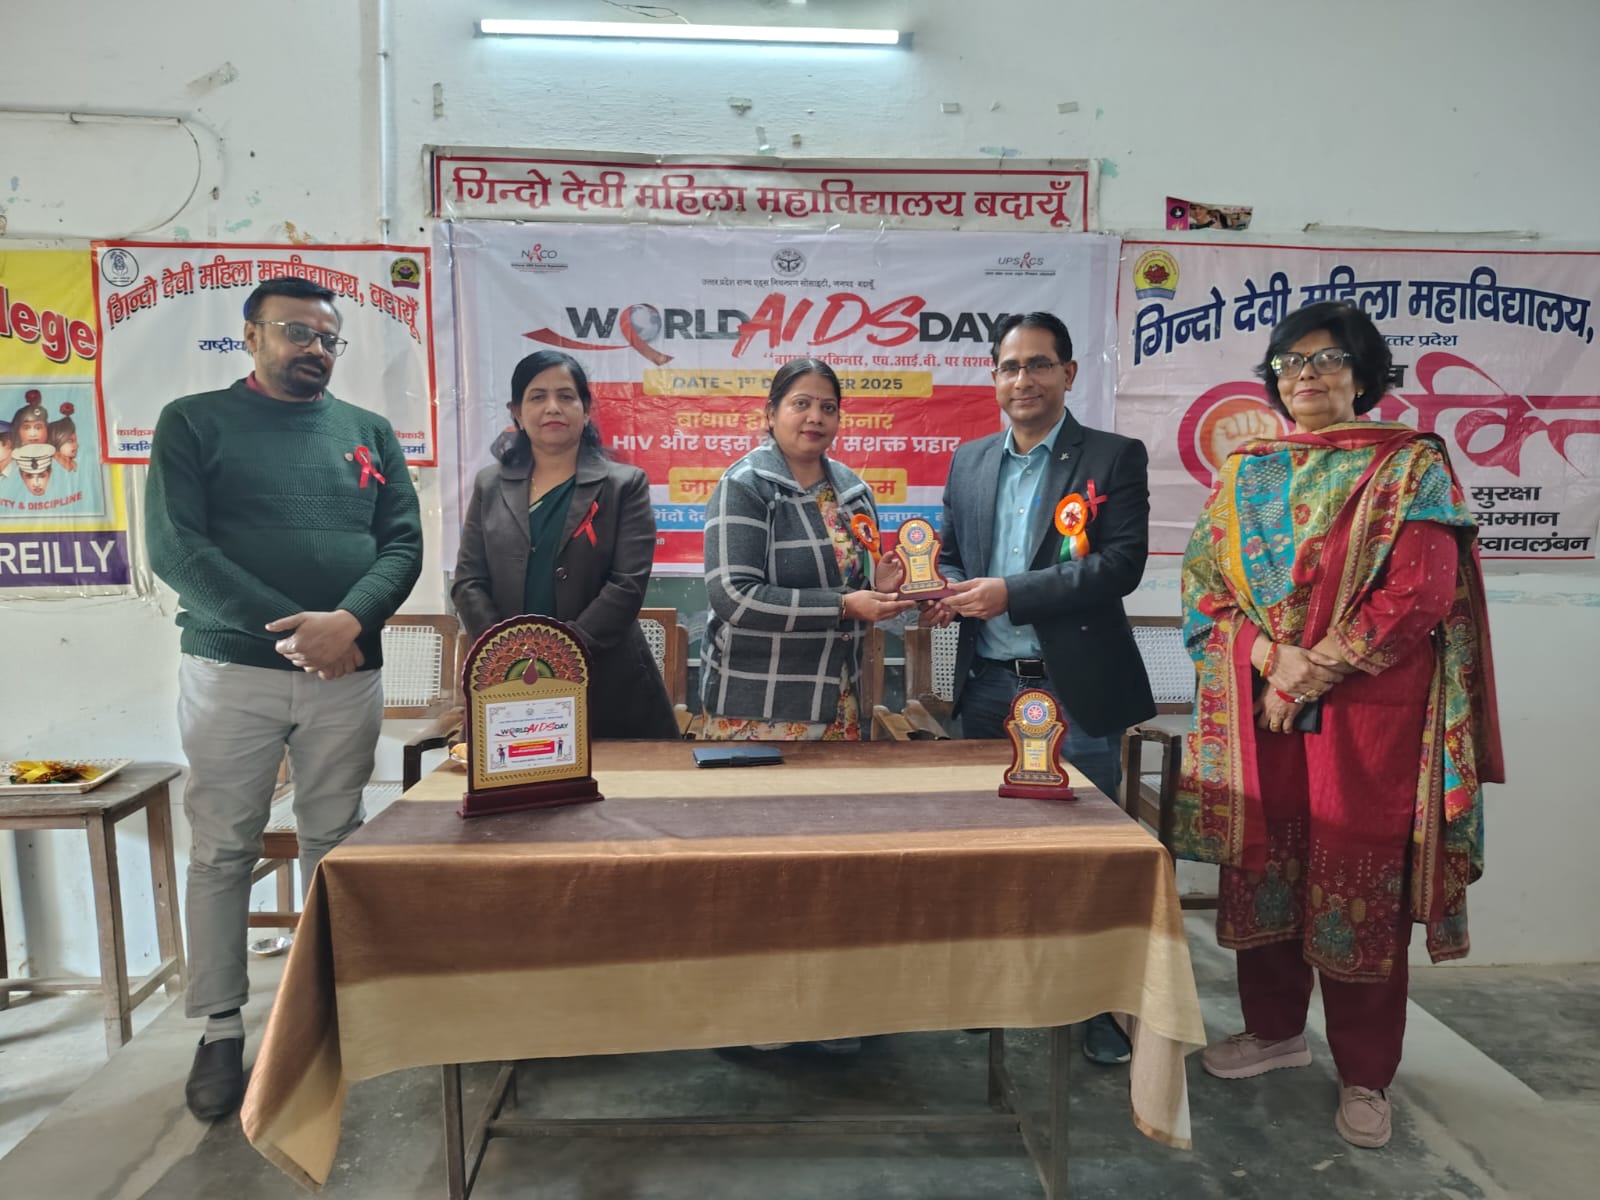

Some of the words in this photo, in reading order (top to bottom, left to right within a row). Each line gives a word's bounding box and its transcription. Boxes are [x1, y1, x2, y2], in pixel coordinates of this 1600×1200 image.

[452, 167, 552, 209] गिन्दो
[560, 170, 627, 211] देवी
[634, 174, 748, 215] महिला
[755, 178, 967, 218] महाविद्यालय
[973, 181, 1072, 227] बदायूँ
[107, 276, 158, 330] गिन्दो
[162, 261, 194, 298] देवी
[198, 254, 254, 290] महिला
[731, 292, 926, 359] AIDS
[919, 311, 1009, 342] DAY
[1134, 286, 1226, 366] गिन्दो
[1234, 271, 1292, 332] देवी
[1418, 332, 1459, 348] प्रदेश
[673, 377, 719, 389] DATE
[861, 378, 903, 390] 2025
[612, 434, 654, 451] HIV
[659, 428, 700, 451] और
[703, 435, 752, 457] एड्स
[842, 435, 908, 453] सशक्त
[1470, 486, 1542, 509] सुरक्षा
[0, 540, 115, 574] REILLY
